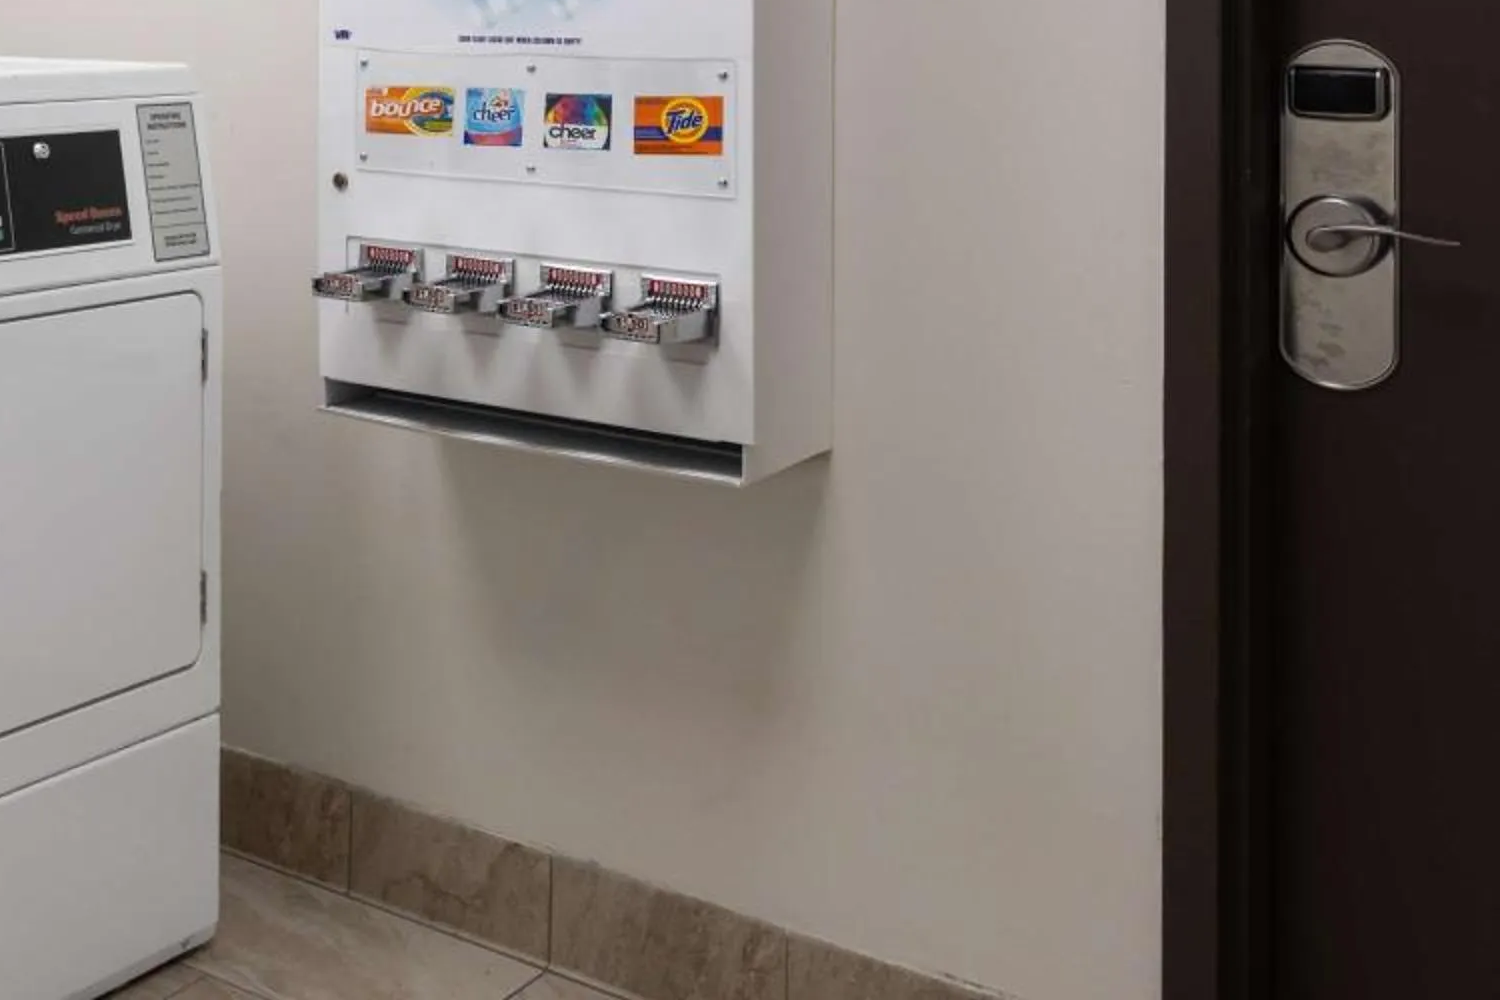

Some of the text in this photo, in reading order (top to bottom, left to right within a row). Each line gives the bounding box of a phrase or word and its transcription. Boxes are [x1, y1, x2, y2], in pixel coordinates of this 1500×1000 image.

[371, 98, 441, 117] bounce
[473, 102, 515, 122] cheer
[666, 109, 703, 134] Tide
[550, 123, 596, 140] cheer
